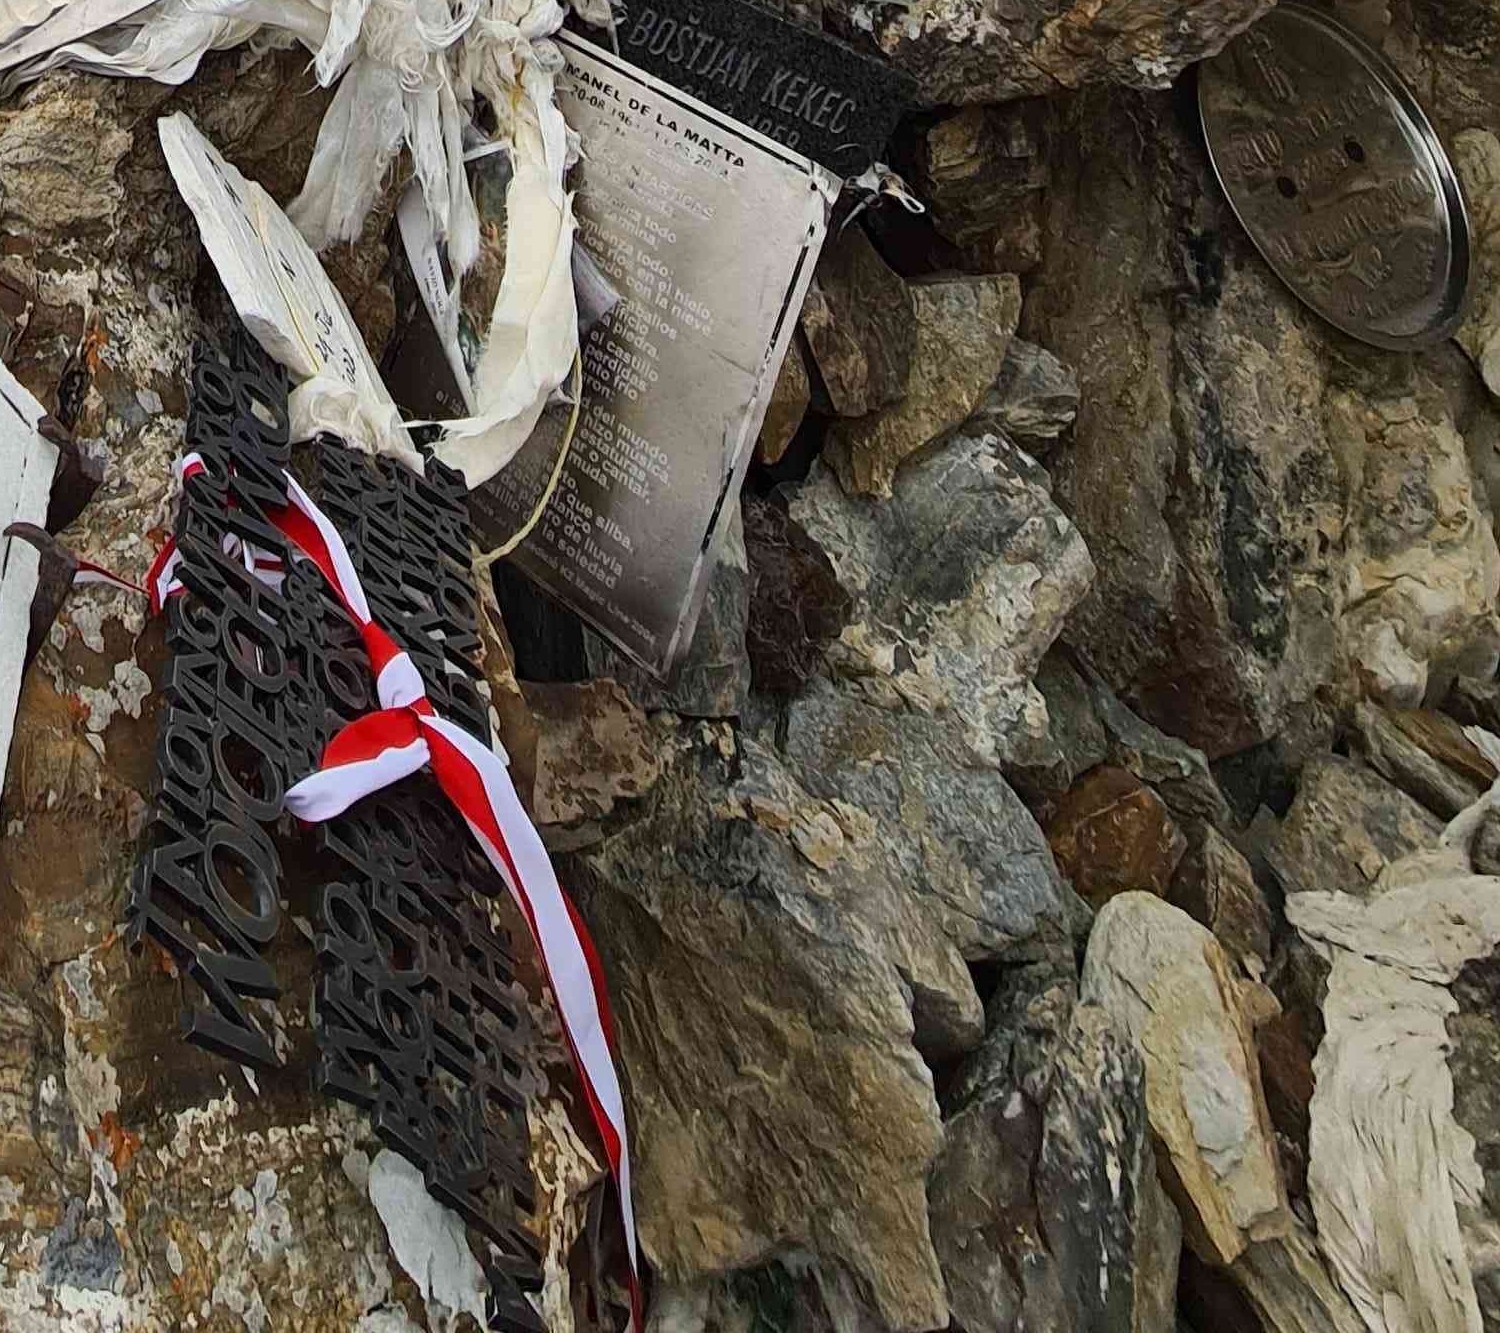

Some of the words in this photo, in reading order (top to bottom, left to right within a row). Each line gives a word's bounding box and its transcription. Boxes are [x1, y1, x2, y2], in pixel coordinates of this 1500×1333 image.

[564, 63, 622, 102] MANEL
[627, 97, 651, 116] DE
[656, 113, 679, 134] LA
[683, 128, 746, 168] MATTA
[627, 8, 761, 92] BOŠTJAN
[760, 67, 857, 134] KEKEC
[607, 338, 658, 382] castillo
